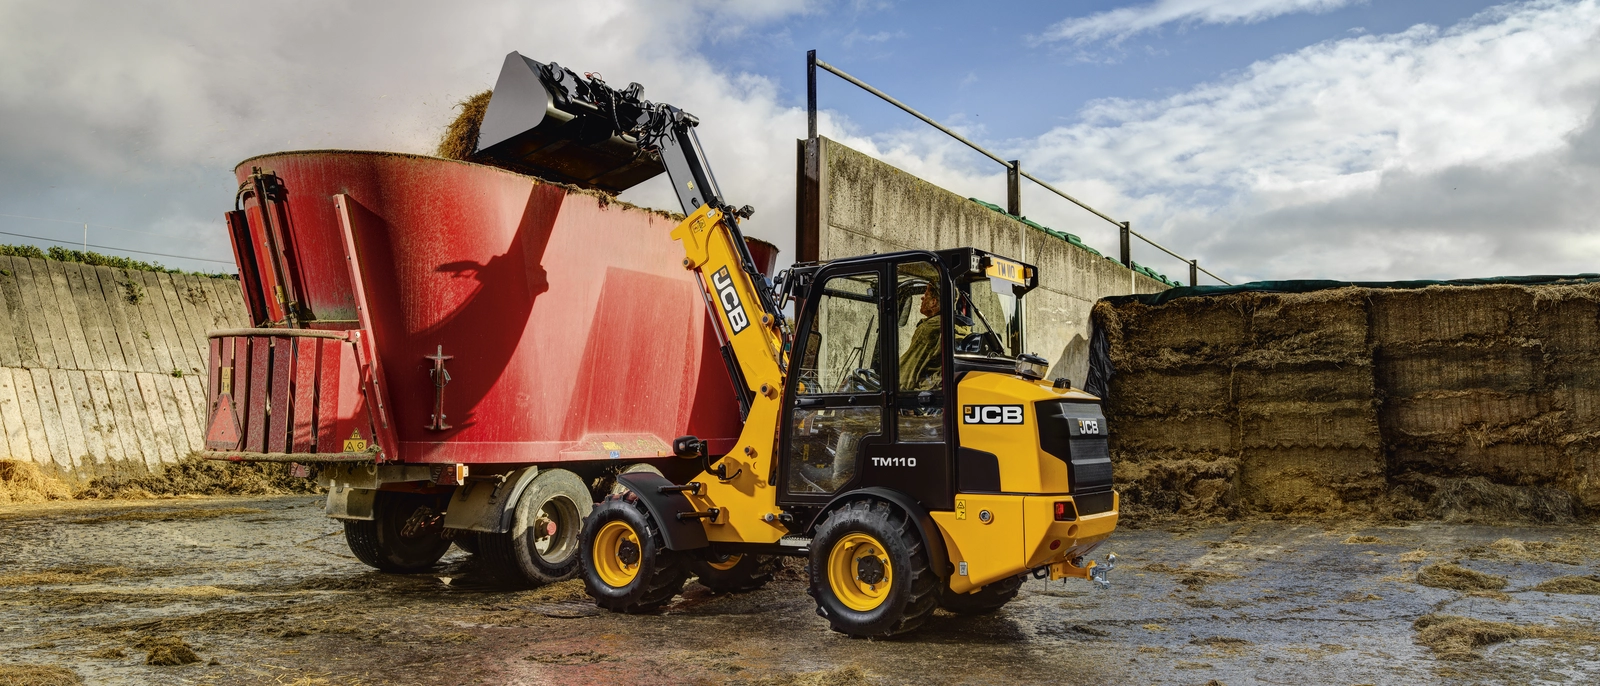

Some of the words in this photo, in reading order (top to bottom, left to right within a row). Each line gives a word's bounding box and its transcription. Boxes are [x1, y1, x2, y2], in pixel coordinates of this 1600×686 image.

[997, 261, 1006, 277] TM
[713, 272, 748, 332] JCB
[965, 406, 1023, 424] JCB
[1079, 420, 1099, 435] JCB
[871, 457, 917, 467] TM110
